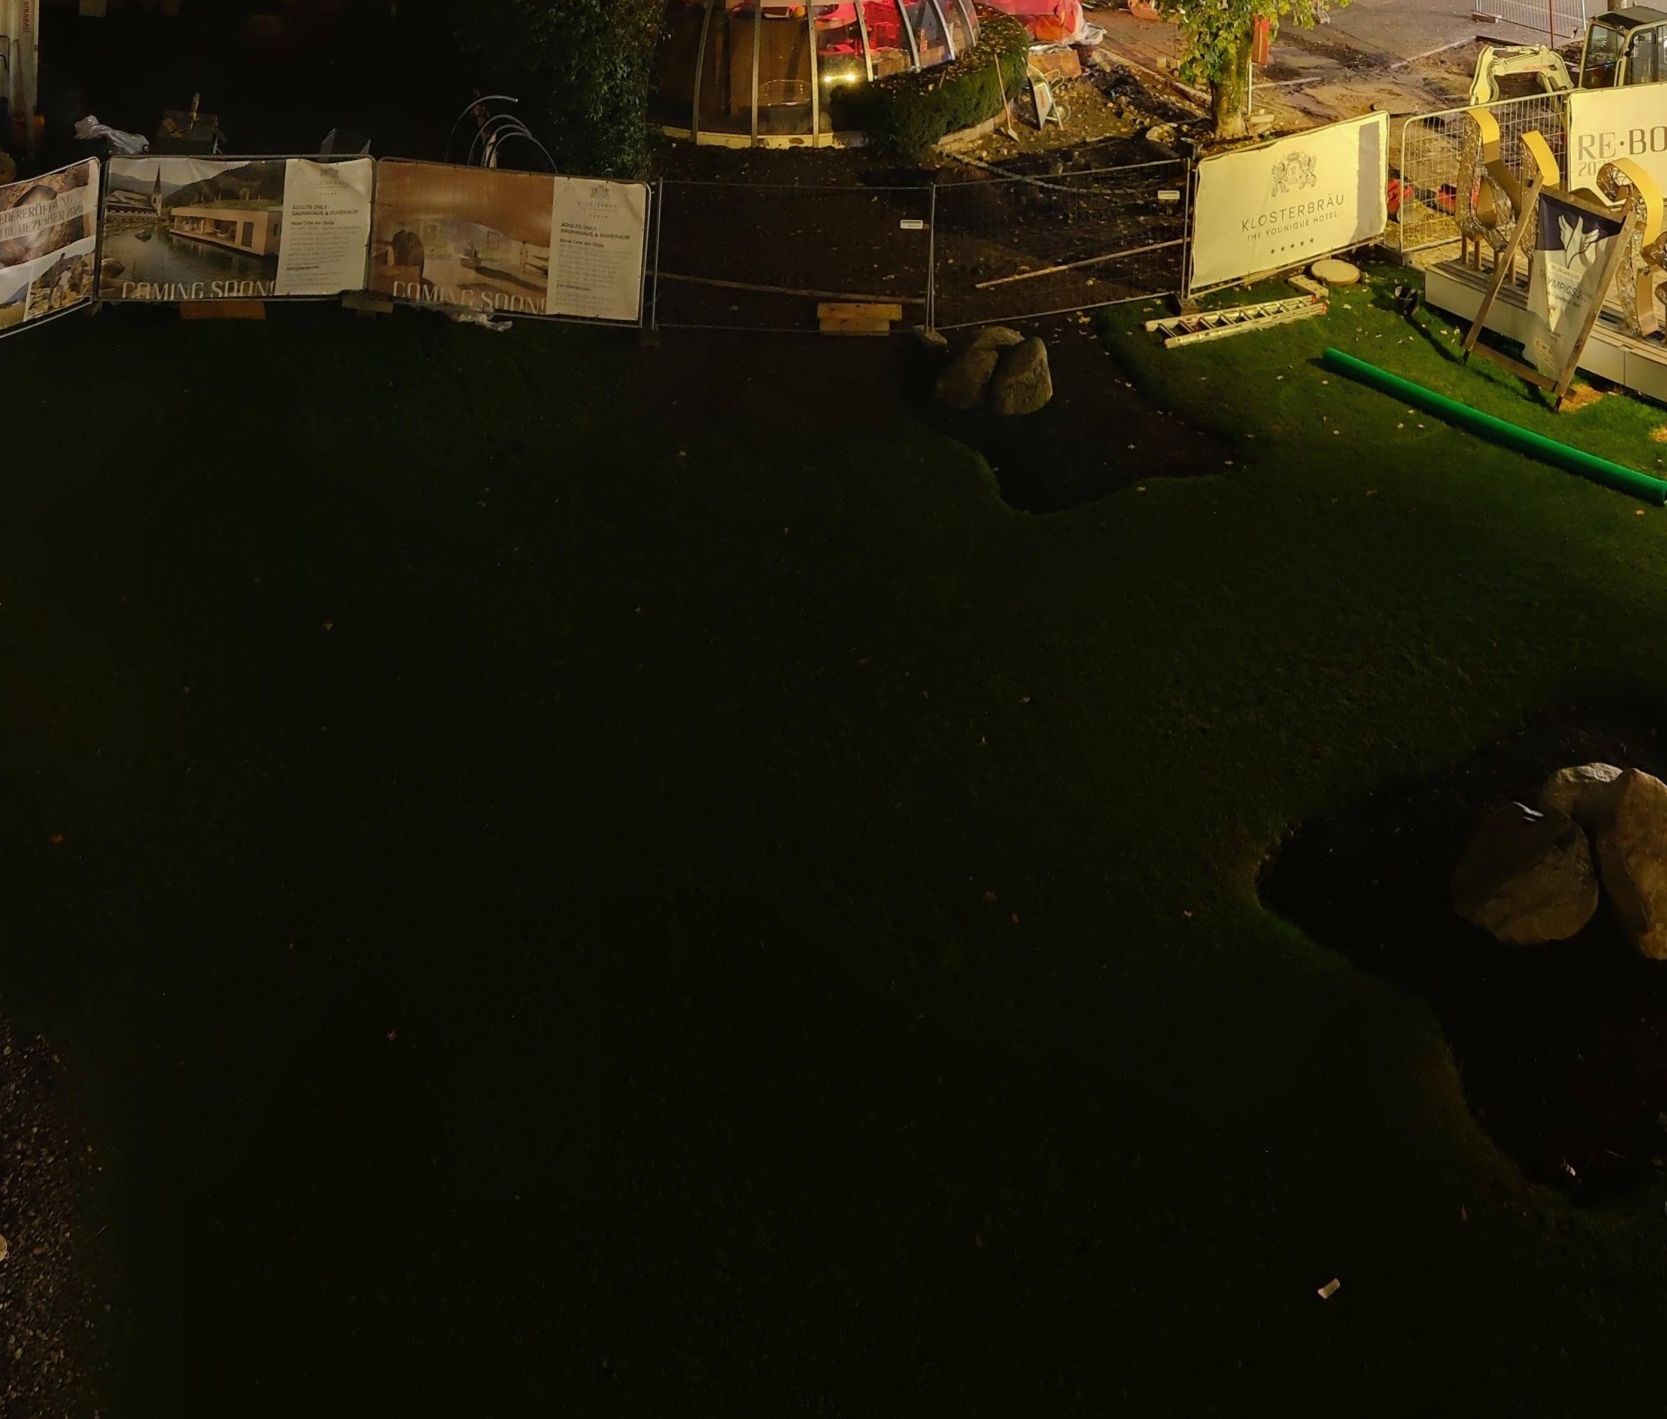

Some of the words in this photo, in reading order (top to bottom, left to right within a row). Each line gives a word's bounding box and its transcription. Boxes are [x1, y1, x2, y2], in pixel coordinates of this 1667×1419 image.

[1241, 192, 1345, 233] KLOSTERBRÄU
[1265, 219, 1311, 237] YOUNIQUE
[1313, 210, 1338, 225] HOTEL
